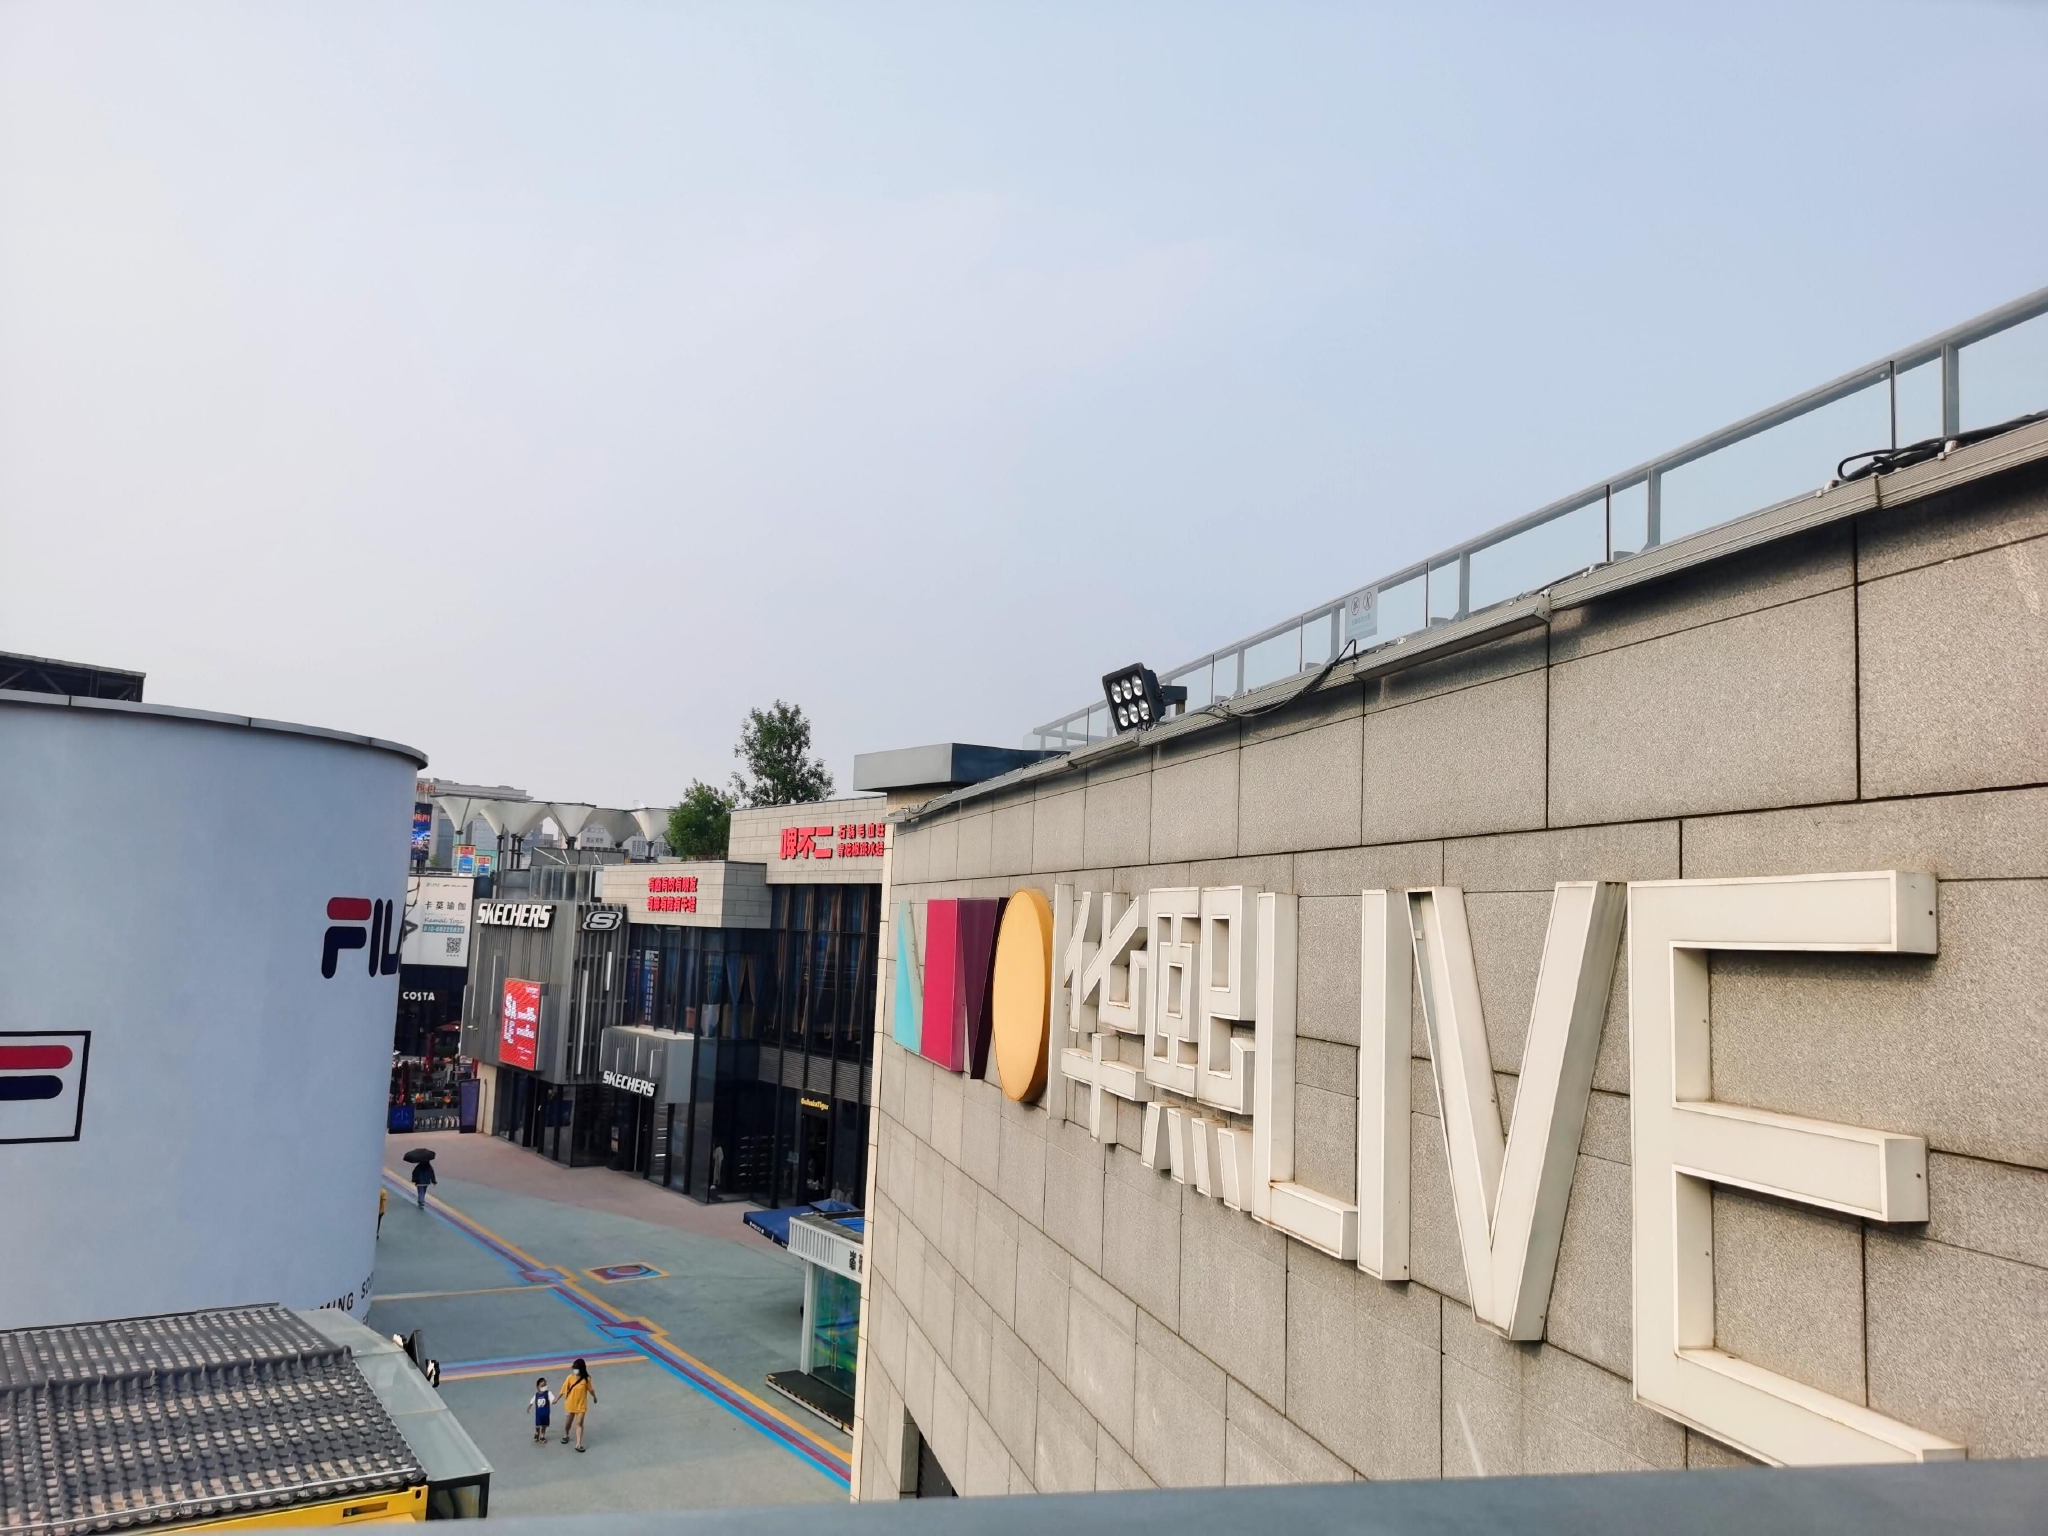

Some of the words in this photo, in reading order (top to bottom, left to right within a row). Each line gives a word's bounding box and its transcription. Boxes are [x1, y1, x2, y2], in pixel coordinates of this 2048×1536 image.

[780, 826, 833, 859] 啤不二
[476, 902, 551, 928] SKECHERS
[321, 897, 401, 979] FIL
[402, 991, 435, 1001] COSTA
[602, 1070, 656, 1097] SKECHERS
